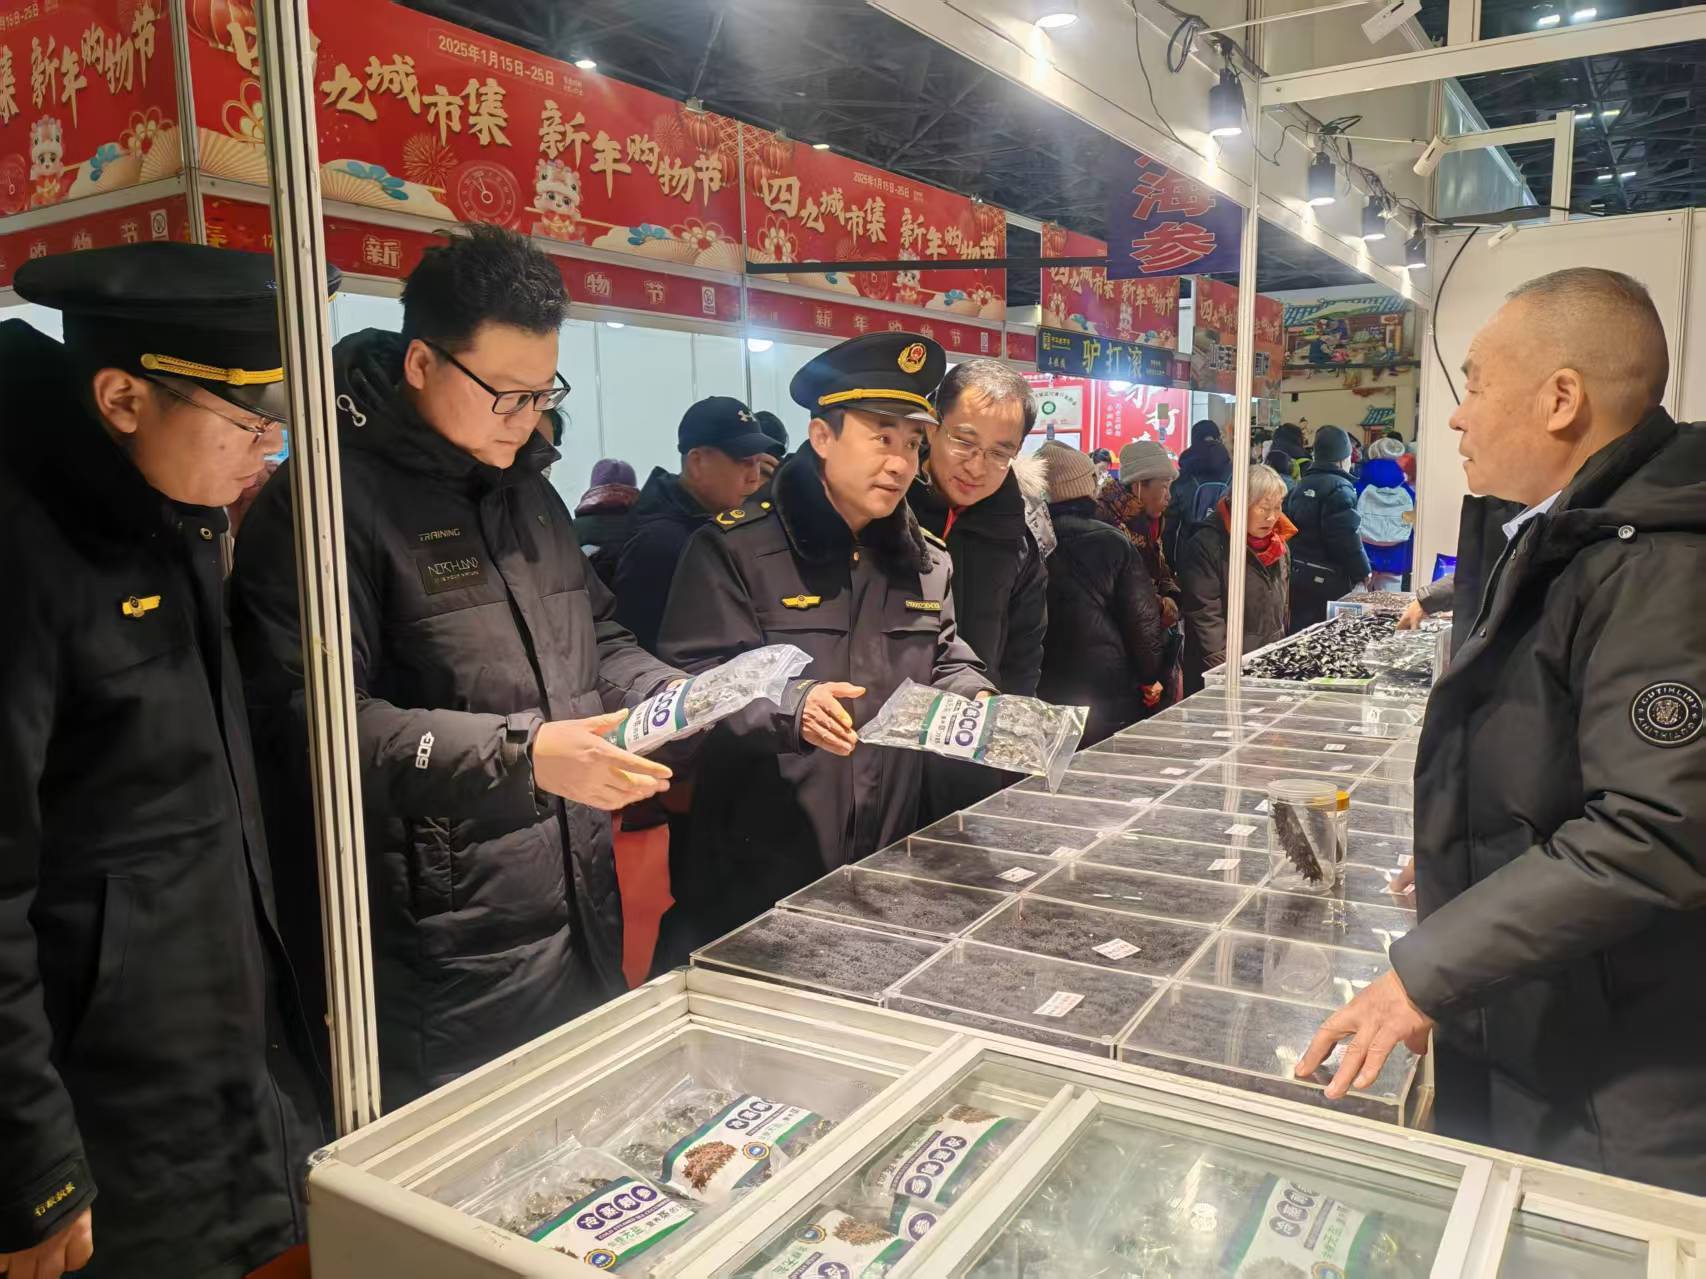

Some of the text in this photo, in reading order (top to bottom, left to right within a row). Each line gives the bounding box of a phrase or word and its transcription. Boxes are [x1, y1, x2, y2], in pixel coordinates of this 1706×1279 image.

[438, 35, 554, 86] 2025年1月15日-25日
[538, 99, 723, 207] 新年购物节
[761, 176, 887, 244] 四九城市集
[1129, 152, 1218, 274] 海参
